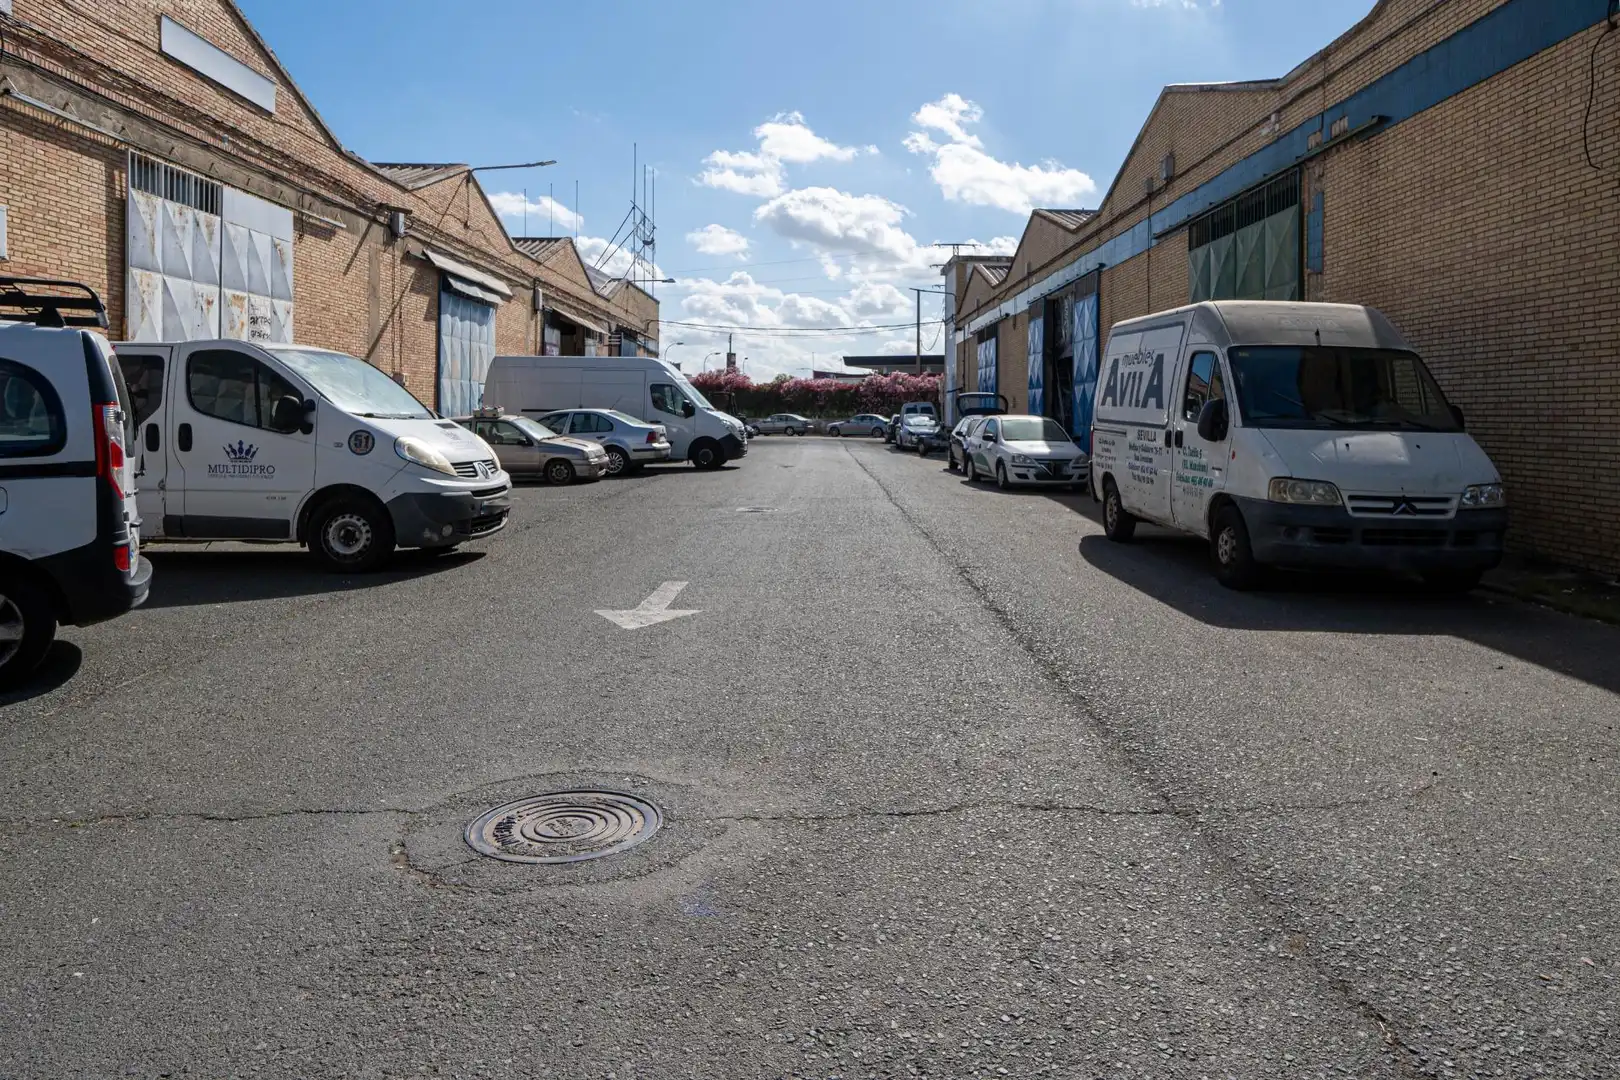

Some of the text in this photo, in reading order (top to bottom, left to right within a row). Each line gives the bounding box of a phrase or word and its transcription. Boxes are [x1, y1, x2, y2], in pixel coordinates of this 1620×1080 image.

[1121, 349, 1155, 368] muebles
[353, 434, 371, 449] 51
[1136, 428, 1157, 442] SEVILLA
[208, 464, 276, 474] MULTIDIPRO
